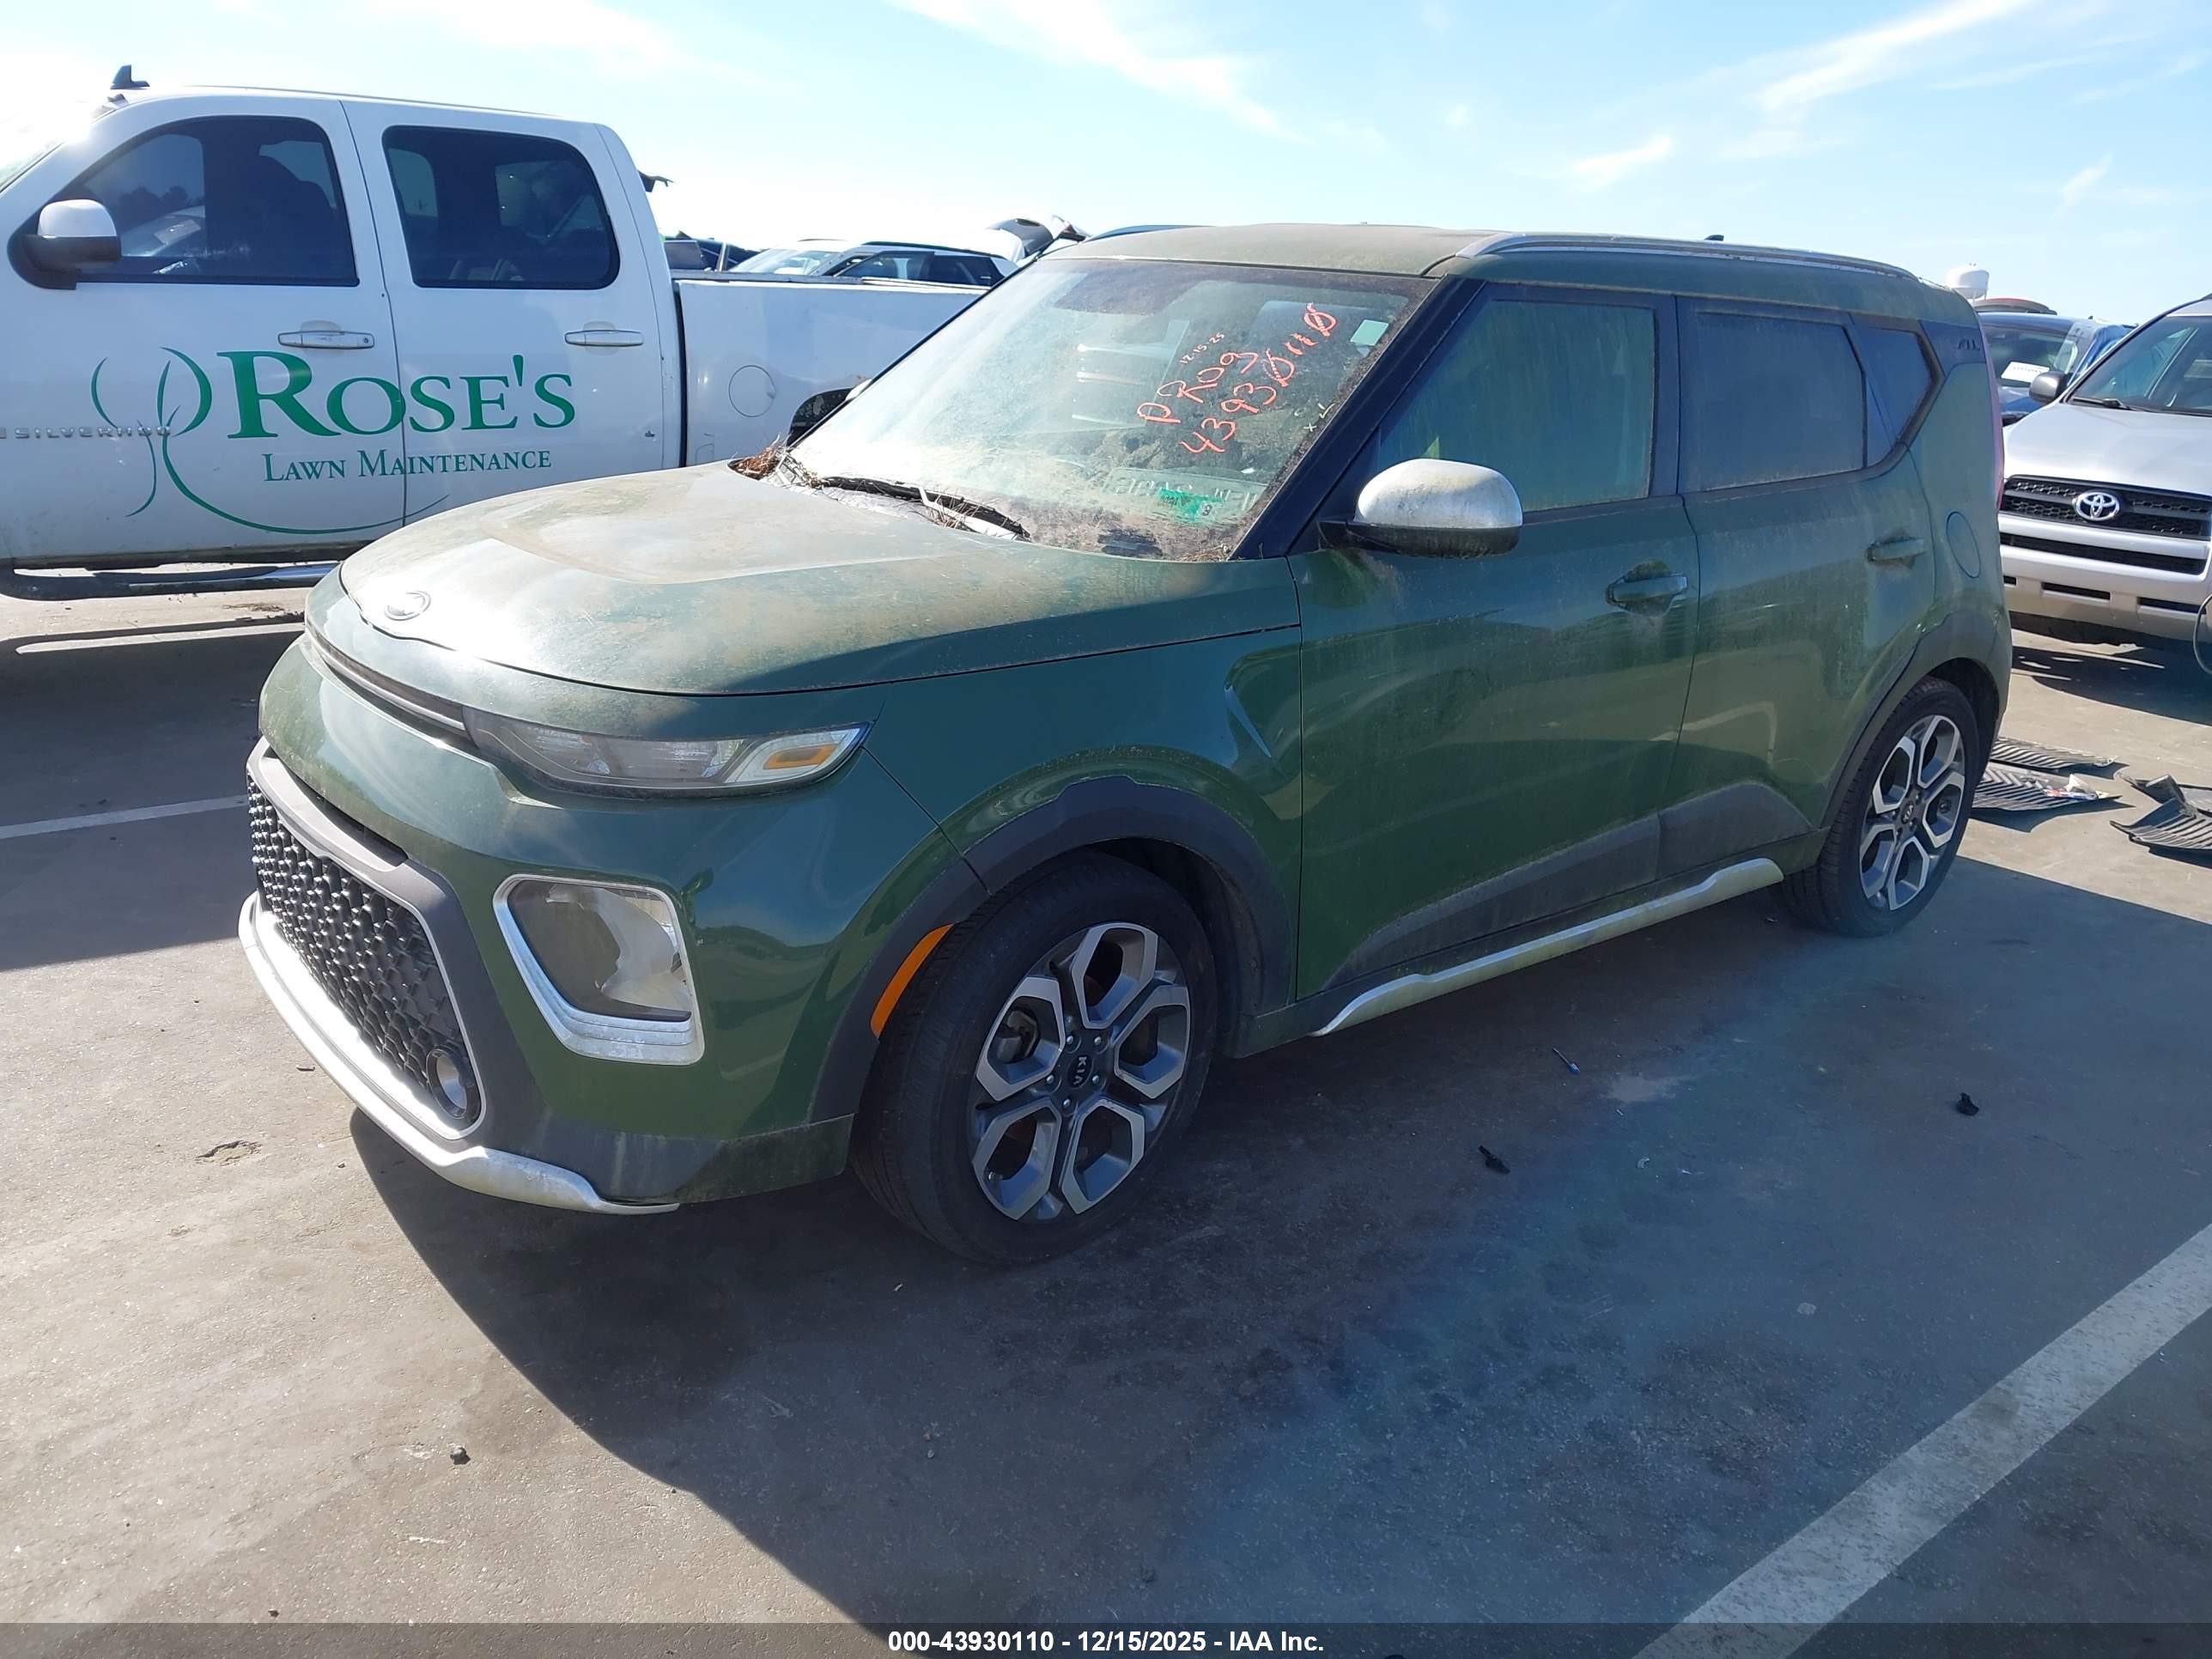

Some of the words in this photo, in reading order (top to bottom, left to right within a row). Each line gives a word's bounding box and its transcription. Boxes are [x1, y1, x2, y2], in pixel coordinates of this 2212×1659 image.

[216, 350, 575, 439] ROSE'S
[263, 453, 346, 483] LAWN
[357, 448, 552, 477] MAINTENANCE
[1073, 1056, 1087, 1085] KIA
